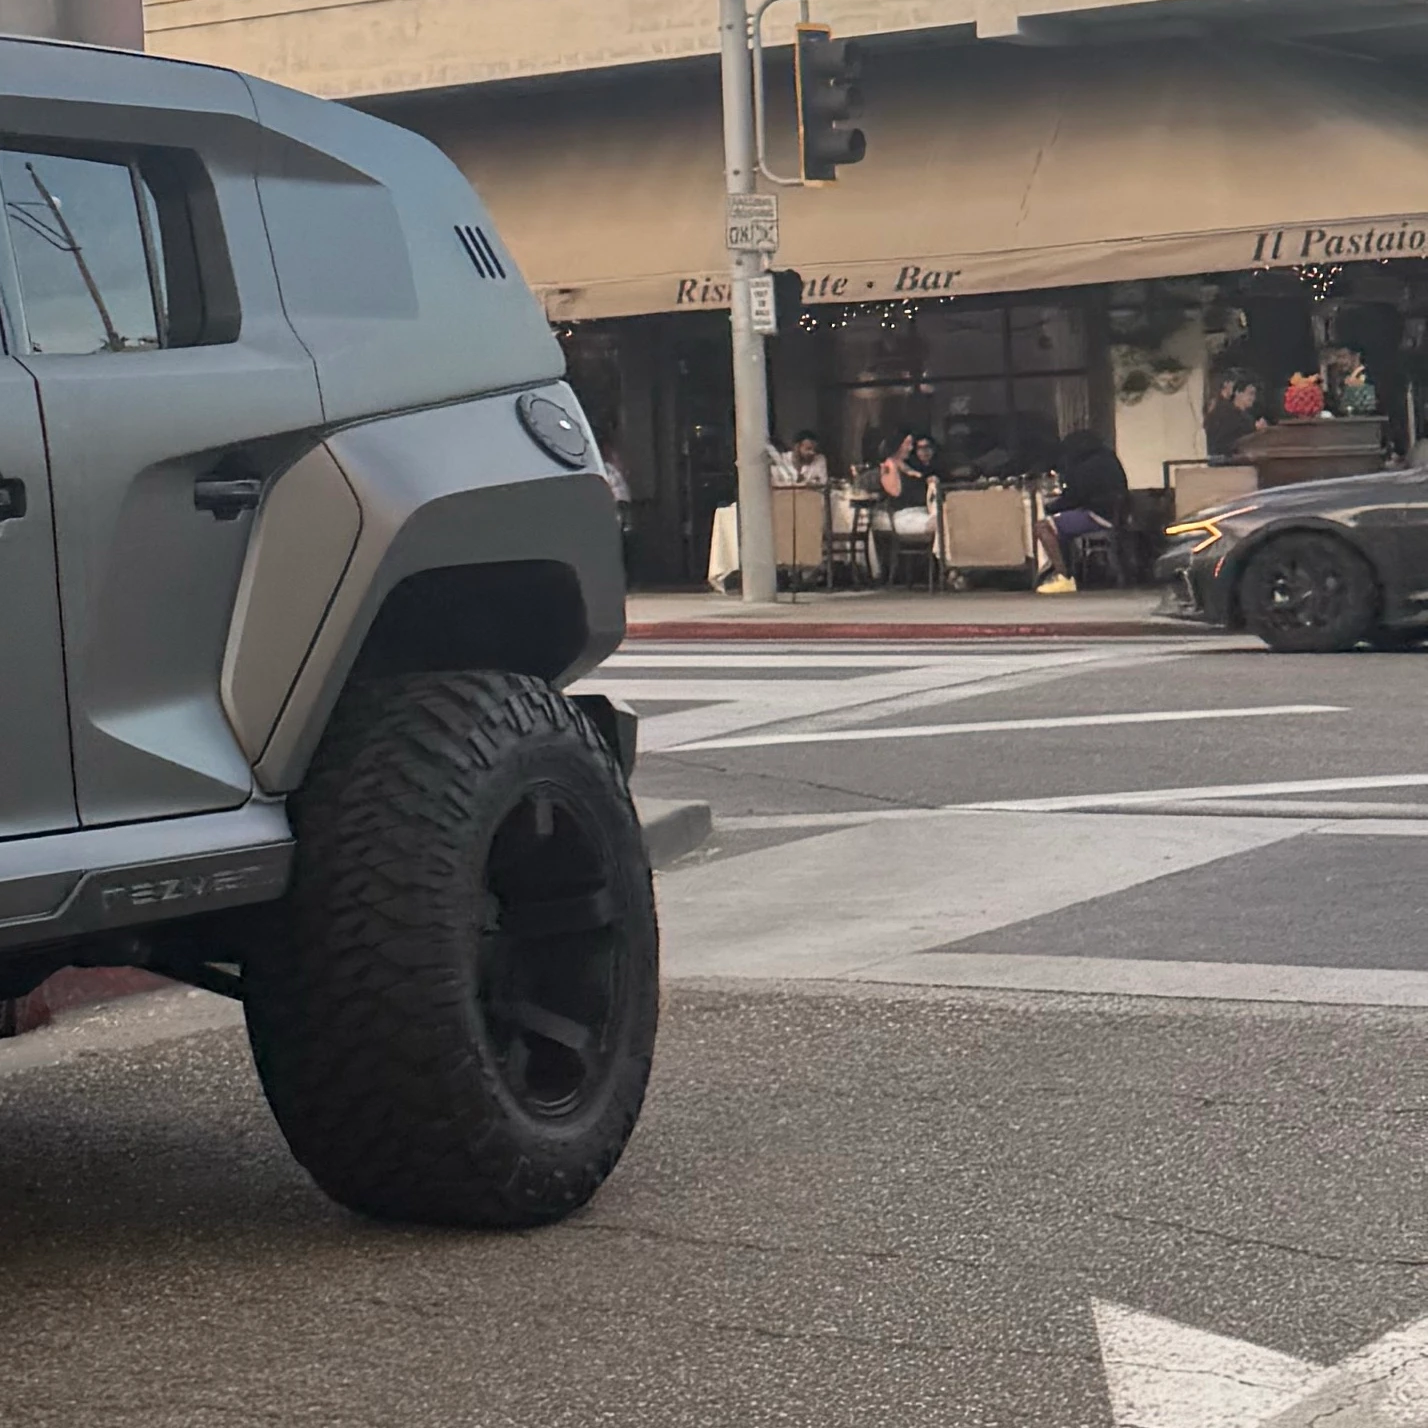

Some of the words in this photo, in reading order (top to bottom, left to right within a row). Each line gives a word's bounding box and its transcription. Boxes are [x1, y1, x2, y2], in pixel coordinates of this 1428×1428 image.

[1253, 230, 1283, 261] Il
[1300, 222, 1425, 258] Pastaio
[893, 265, 962, 292] Bar
